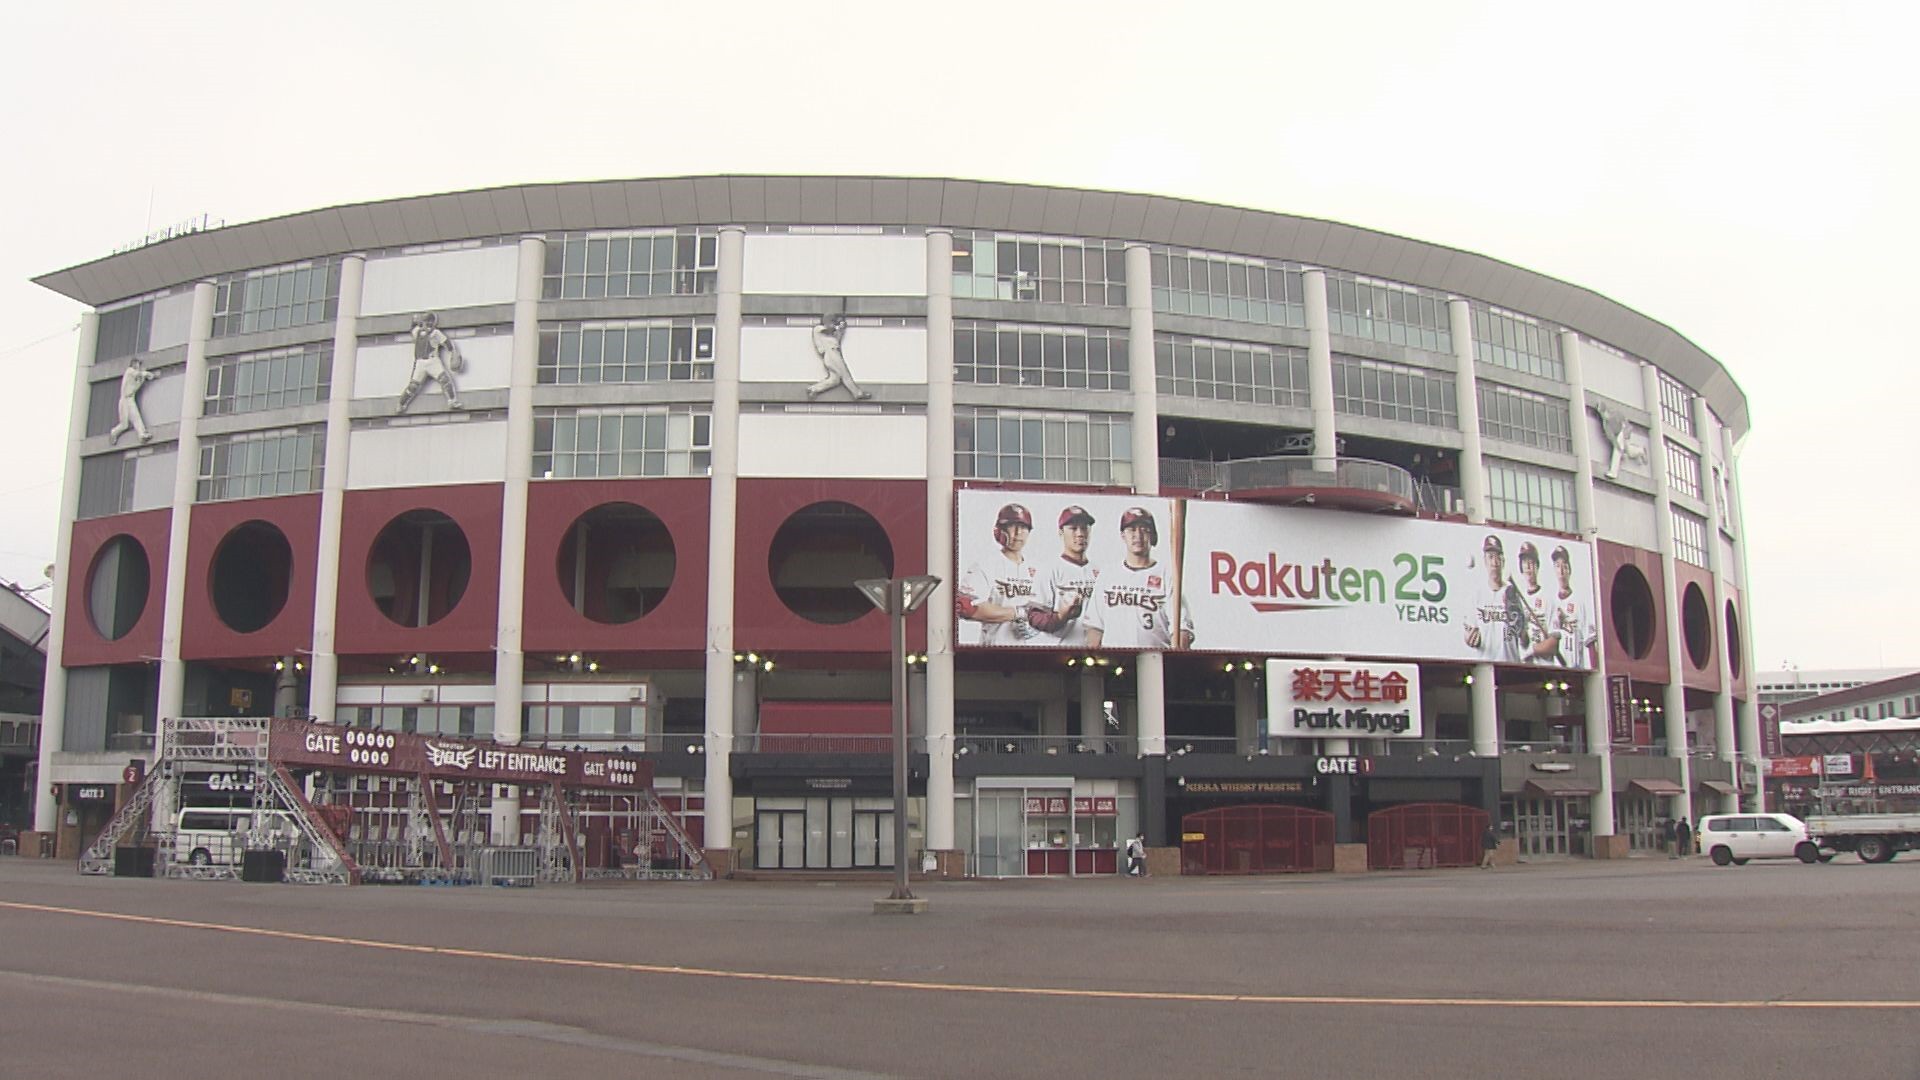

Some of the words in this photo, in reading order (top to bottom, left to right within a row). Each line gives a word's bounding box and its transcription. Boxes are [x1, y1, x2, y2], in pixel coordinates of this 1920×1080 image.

[1211, 551, 1386, 603] Rakuten
[1393, 552, 1448, 602] 25
[1104, 590, 1165, 612] EAGLES
[1143, 613, 1154, 630] 3
[1395, 604, 1449, 624] YEARS
[1292, 667, 1408, 703] 楽天生命
[1294, 707, 1342, 728] Park
[306, 733, 340, 754] GATE
[478, 750, 506, 770] LEFT
[508, 753, 566, 774] ENTRANCE
[584, 760, 604, 776] GATE
[1316, 757, 1357, 774] GATE
[1363, 759, 1369, 773] 1
[209, 772, 254, 790] GA
[80, 788, 98, 799] GATE
